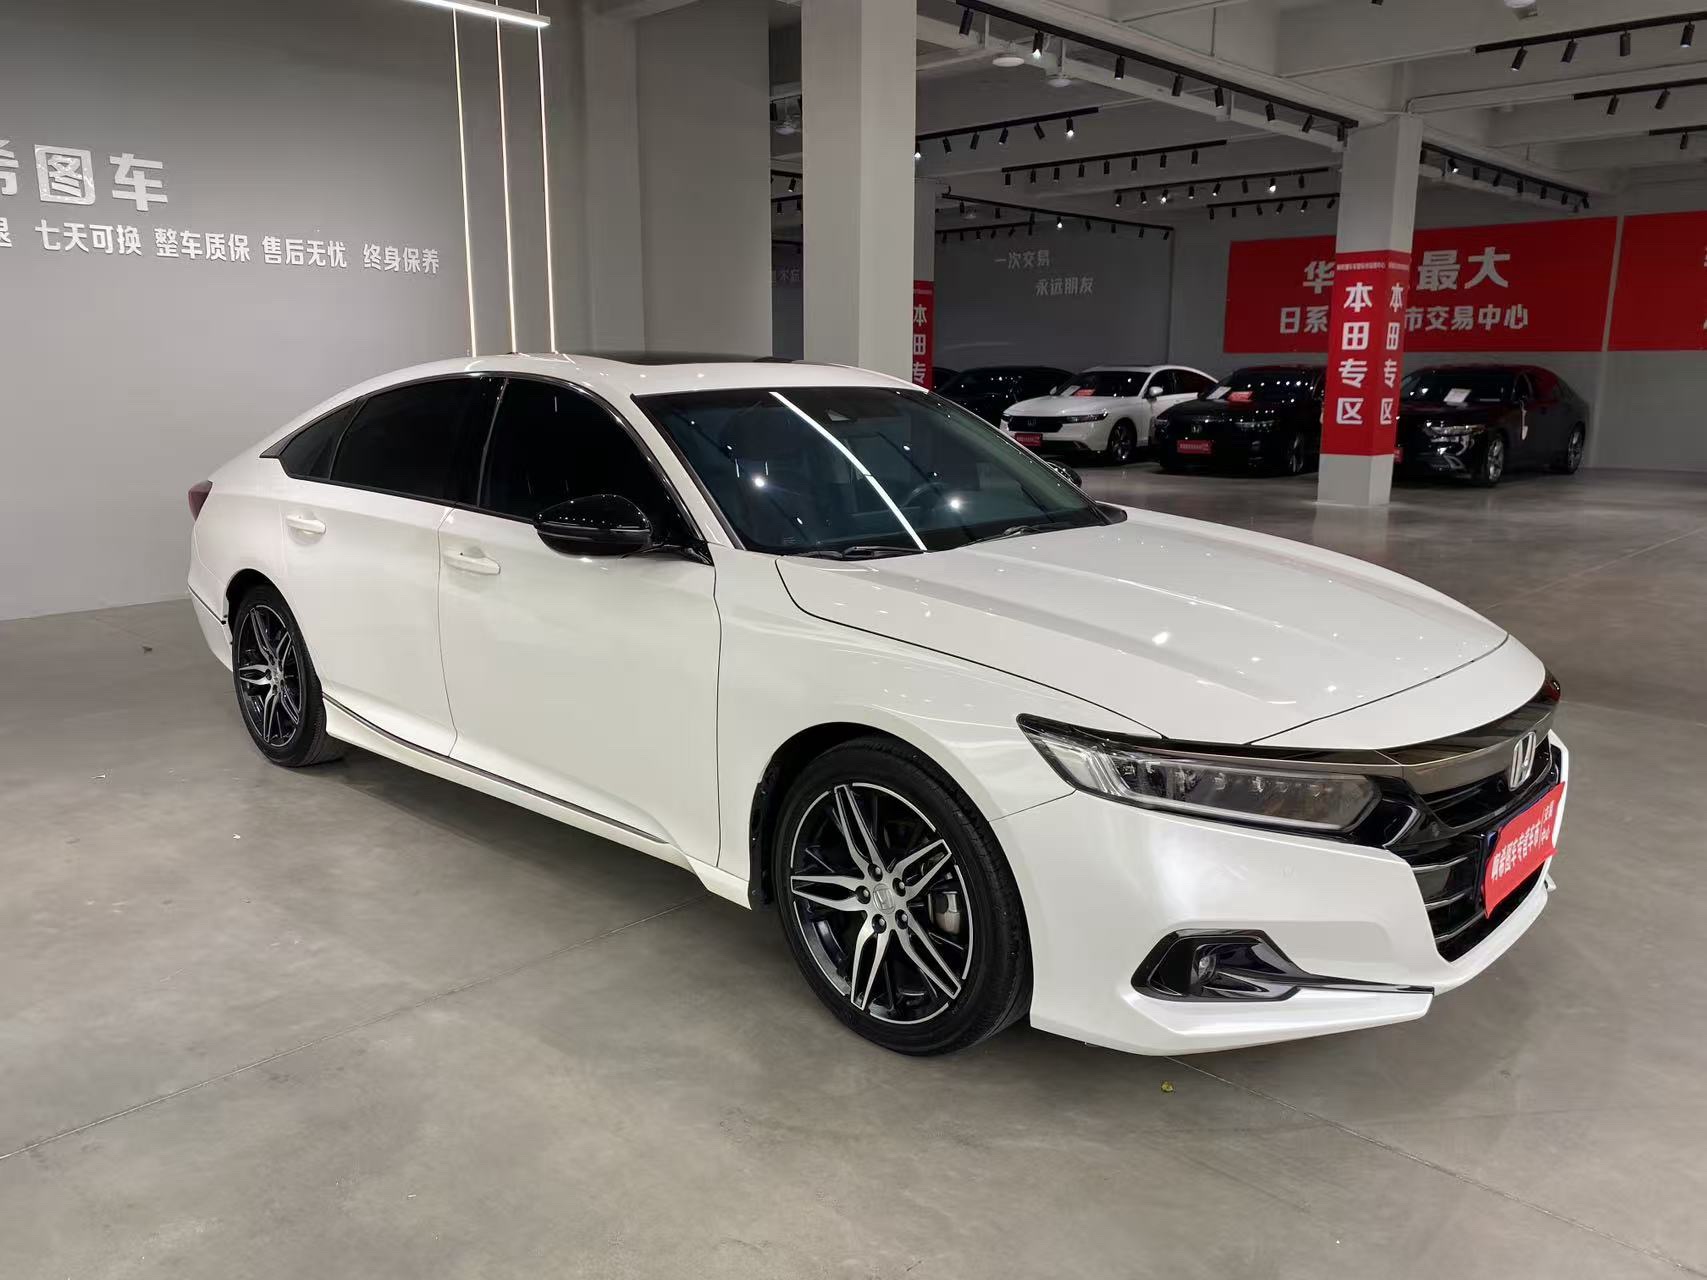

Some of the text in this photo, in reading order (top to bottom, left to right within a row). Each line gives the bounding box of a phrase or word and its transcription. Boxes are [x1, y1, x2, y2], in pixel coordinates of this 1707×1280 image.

[35, 219, 143, 257] 七天可换
[153, 227, 251, 263] 整车质保
[261, 235, 348, 269] 售后无忧
[361, 243, 440, 275] 终身保养
[993, 249, 1050, 270] 一次交易
[1416, 246, 1511, 292] 最大
[1035, 276, 1094, 296] 永远朋友
[1280, 303, 1530, 335] 日系 市交易中心
[1337, 282, 1373, 425] 本田专区
[1380, 283, 1404, 425] 本田专区
